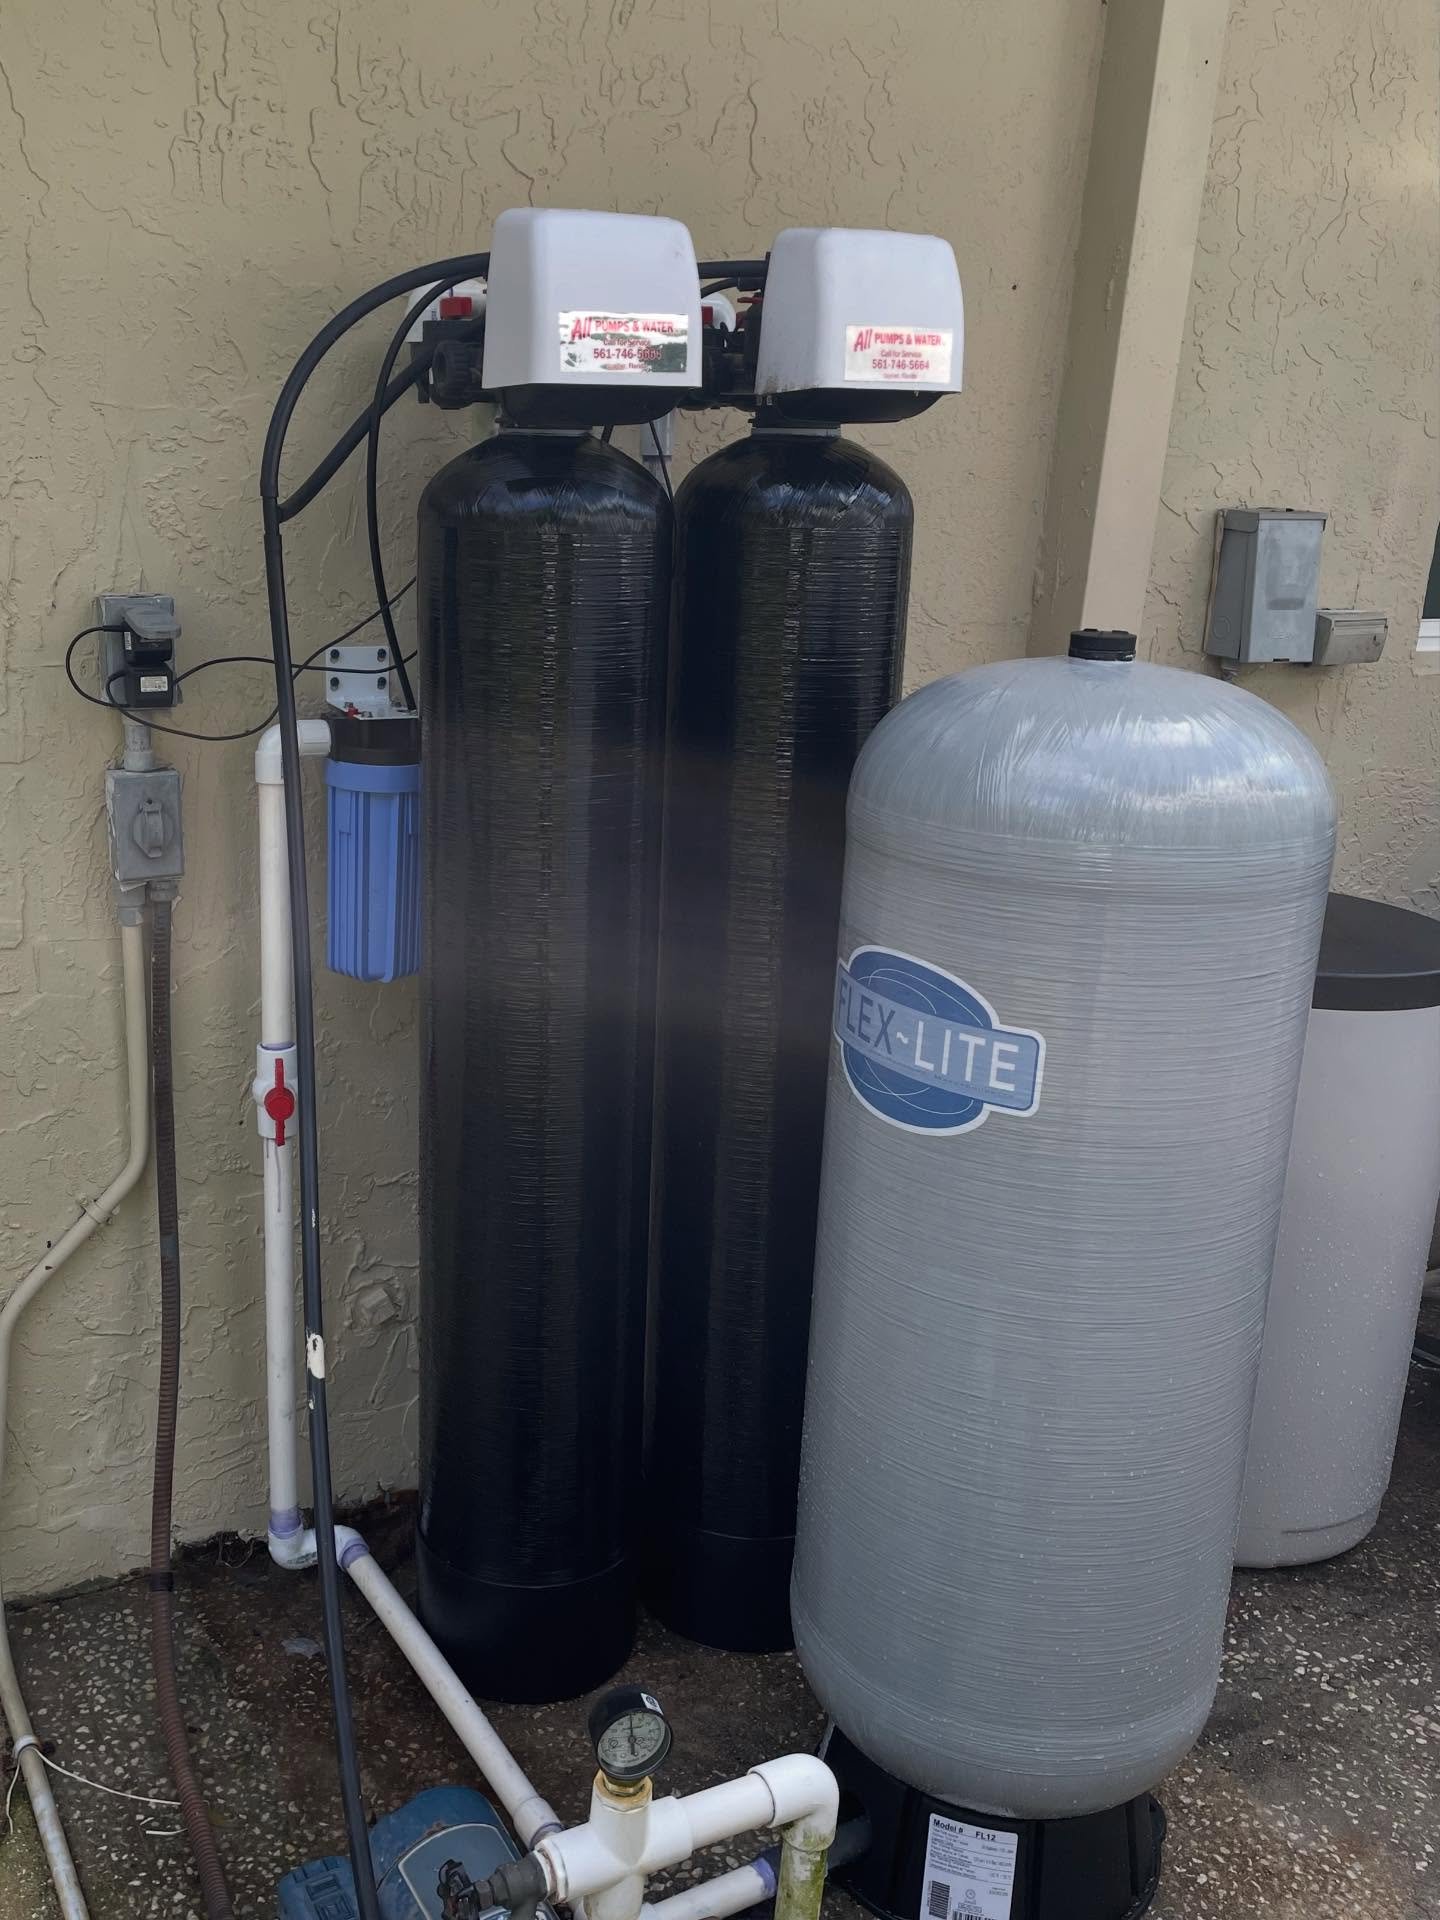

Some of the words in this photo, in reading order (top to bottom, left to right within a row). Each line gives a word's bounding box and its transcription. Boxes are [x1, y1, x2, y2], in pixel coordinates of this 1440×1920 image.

[571, 316, 592, 341] All
[595, 320, 629, 333] PUMPS
[632, 321, 639, 332] &
[642, 321, 674, 333] WATER
[854, 329, 872, 352] All
[875, 333, 904, 345] PUMPS
[905, 334, 912, 345] &
[914, 335, 942, 346] WATER
[872, 359, 930, 370] 561-746-5664
[933, 1818, 957, 1831] Model
[975, 1831, 997, 1841] FL12
